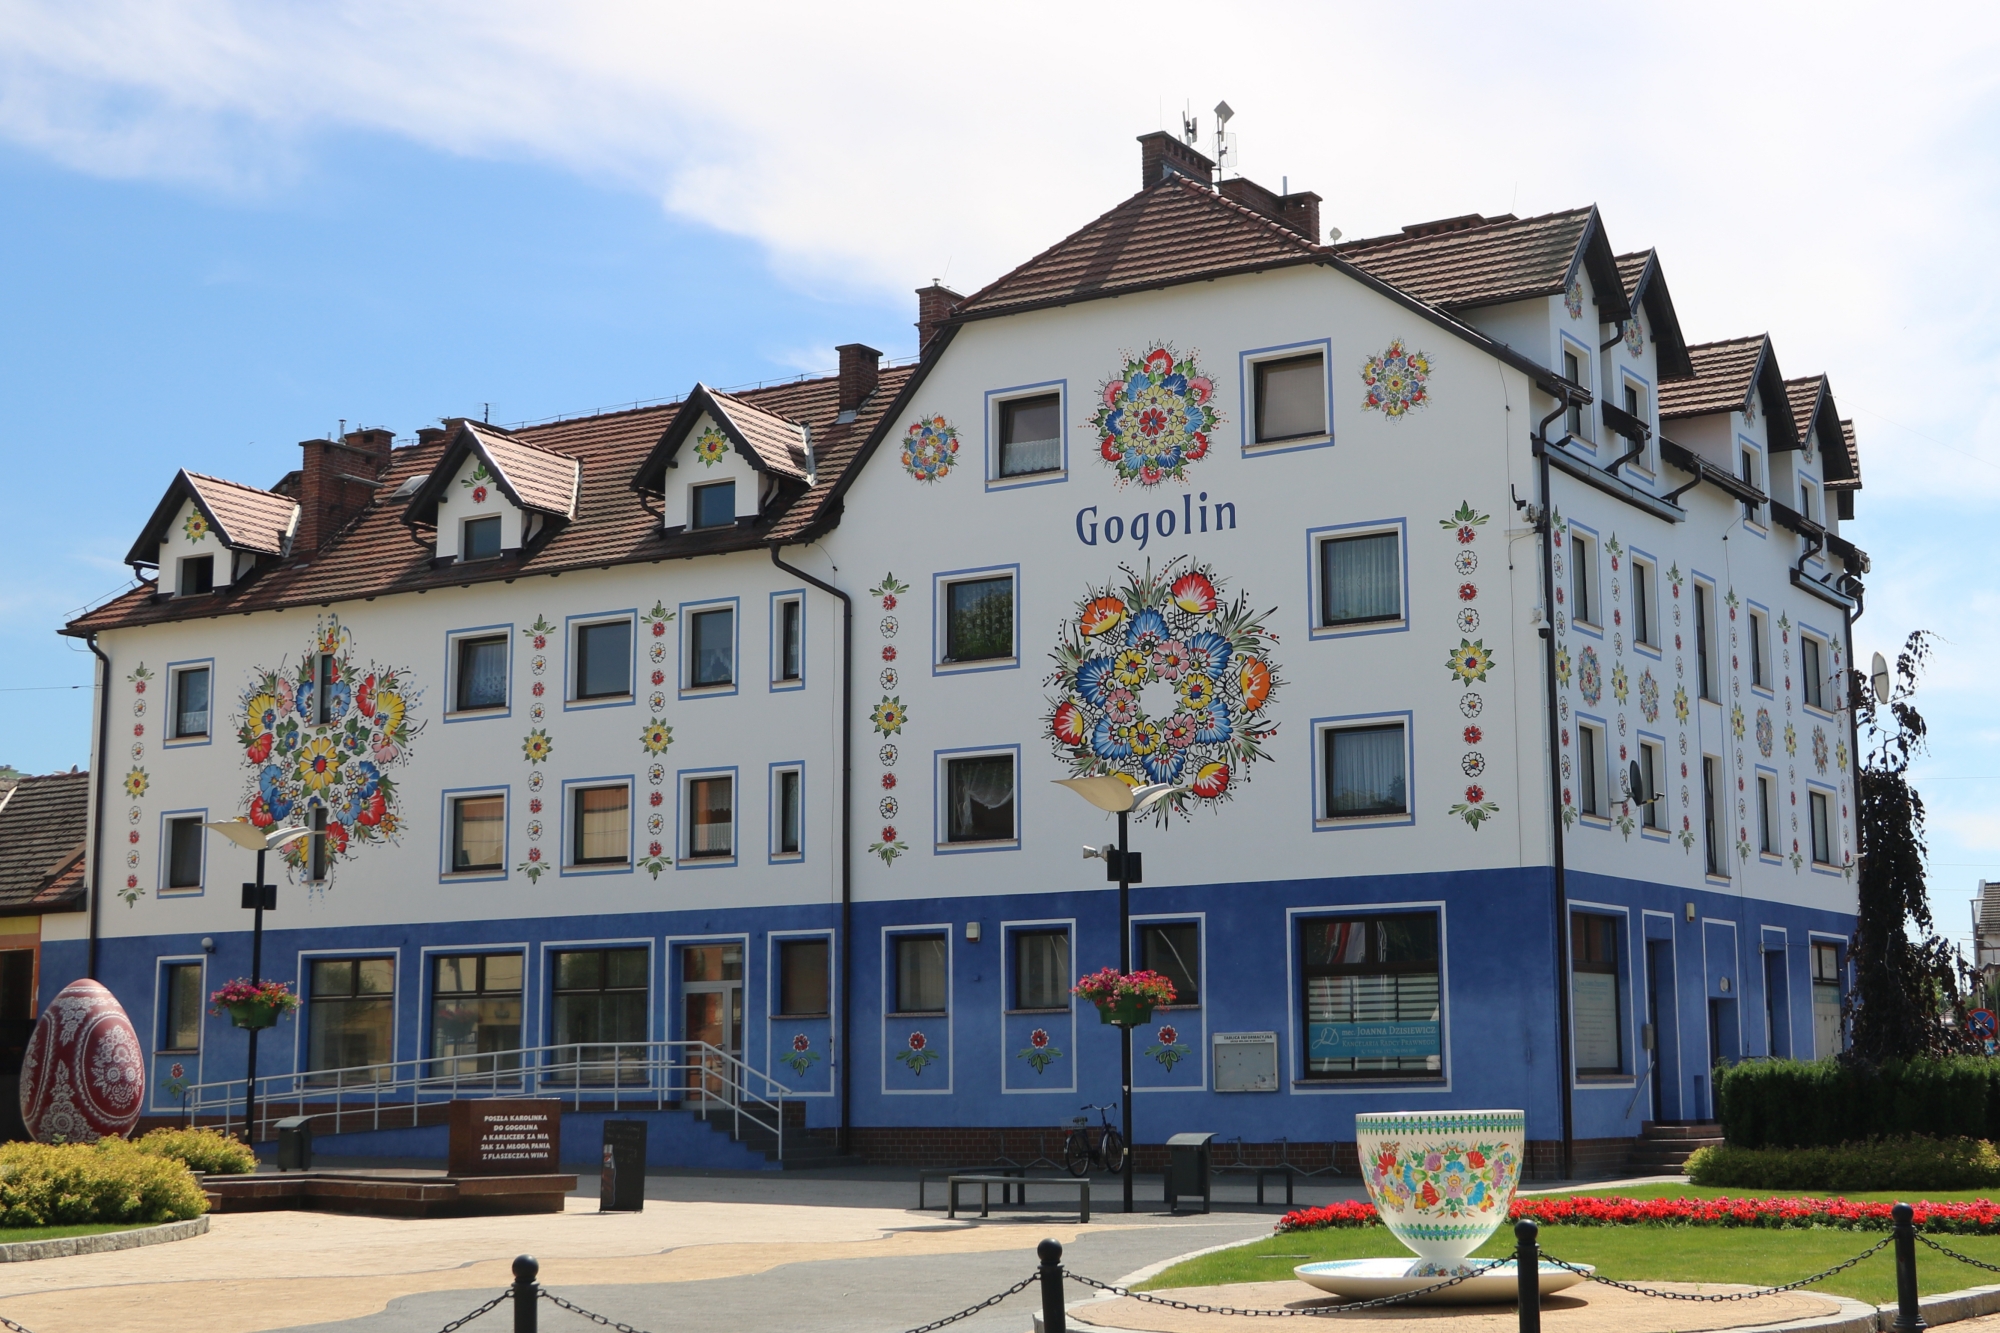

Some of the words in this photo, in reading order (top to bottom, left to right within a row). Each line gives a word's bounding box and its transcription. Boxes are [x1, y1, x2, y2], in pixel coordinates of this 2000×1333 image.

[1076, 491, 1237, 551] Gogolin
[1357, 1026, 1387, 1036] JOANNA
[1389, 1025, 1436, 1035] DZISIEWICZ
[1342, 1039, 1379, 1047] KANCELARIA
[1380, 1039, 1400, 1047] RADCY
[1401, 1038, 1436, 1046] PRAWNEGO
[509, 1114, 548, 1122] KAROLINKA
[489, 1133, 525, 1141] KARLICZEK
[530, 1151, 549, 1159] WINA
